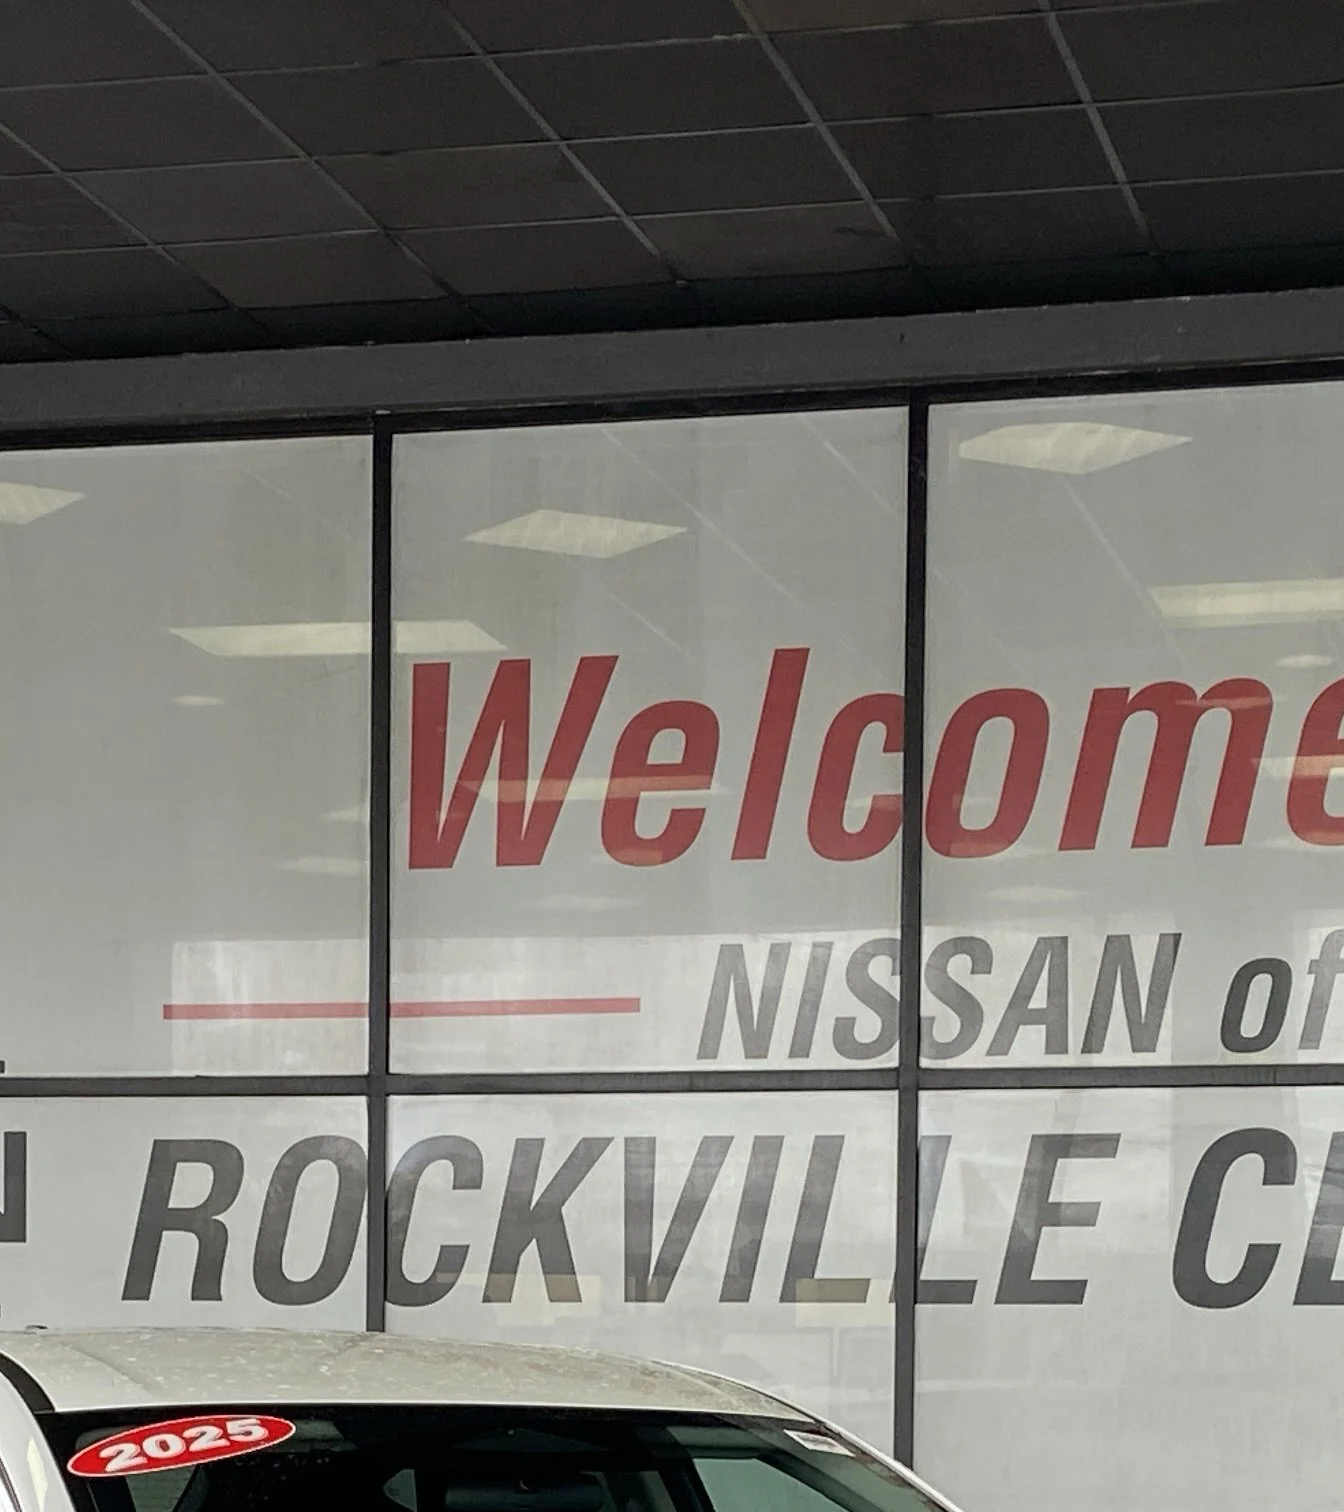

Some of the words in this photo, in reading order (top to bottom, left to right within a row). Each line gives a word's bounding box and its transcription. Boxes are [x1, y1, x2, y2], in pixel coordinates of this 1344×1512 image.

[696, 932, 1183, 1060] NISSAN
[121, 1132, 1121, 1307] ROCKVILLE
[99, 1418, 269, 1472] 2025
